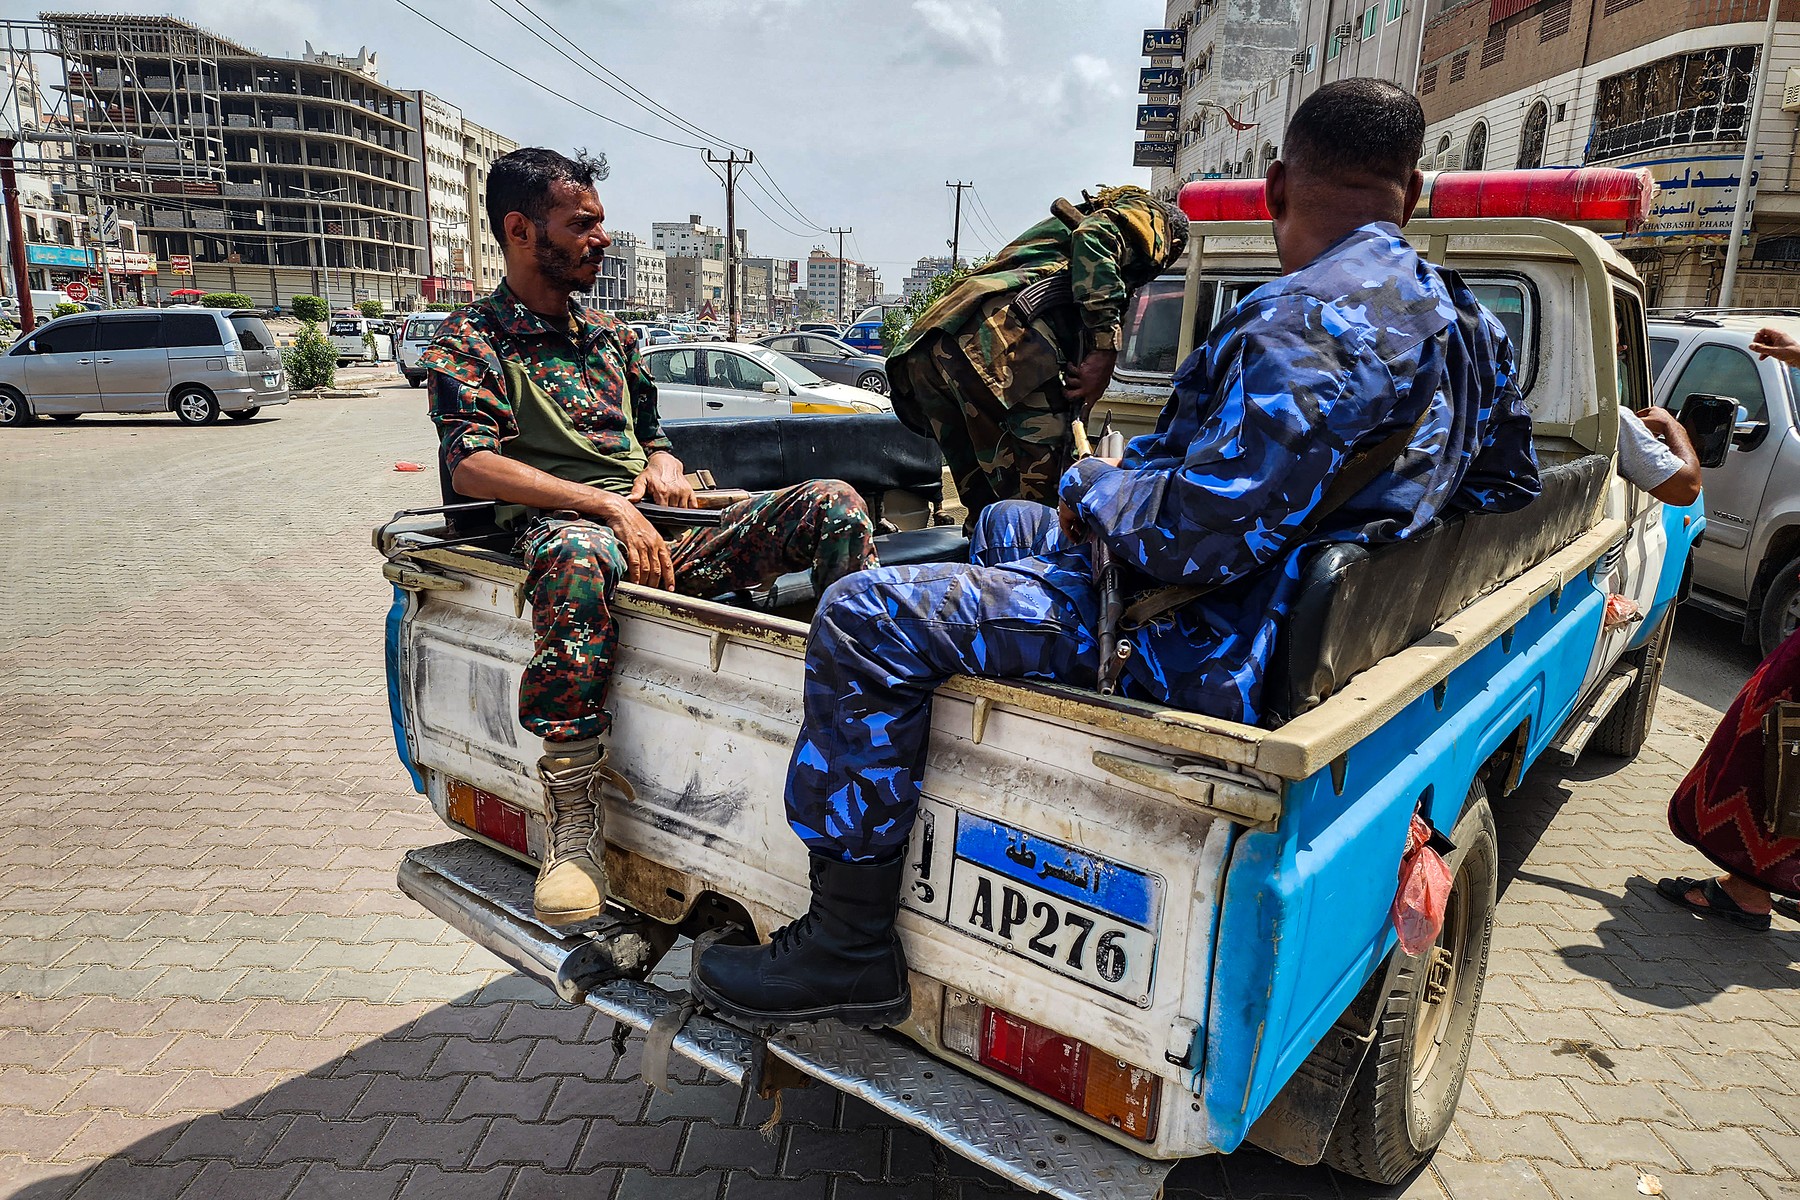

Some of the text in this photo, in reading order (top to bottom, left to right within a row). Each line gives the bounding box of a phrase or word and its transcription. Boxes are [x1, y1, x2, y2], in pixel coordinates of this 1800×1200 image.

[1145, 34, 1183, 53] فندق
[1141, 71, 1179, 90] روابي
[1140, 109, 1175, 126] عدن
[1697, 199, 1755, 219] النبشي
[1699, 220, 1751, 229] PHARMY
[1005, 836, 1102, 894] الشرطة
[968, 876, 1130, 983] AP276
